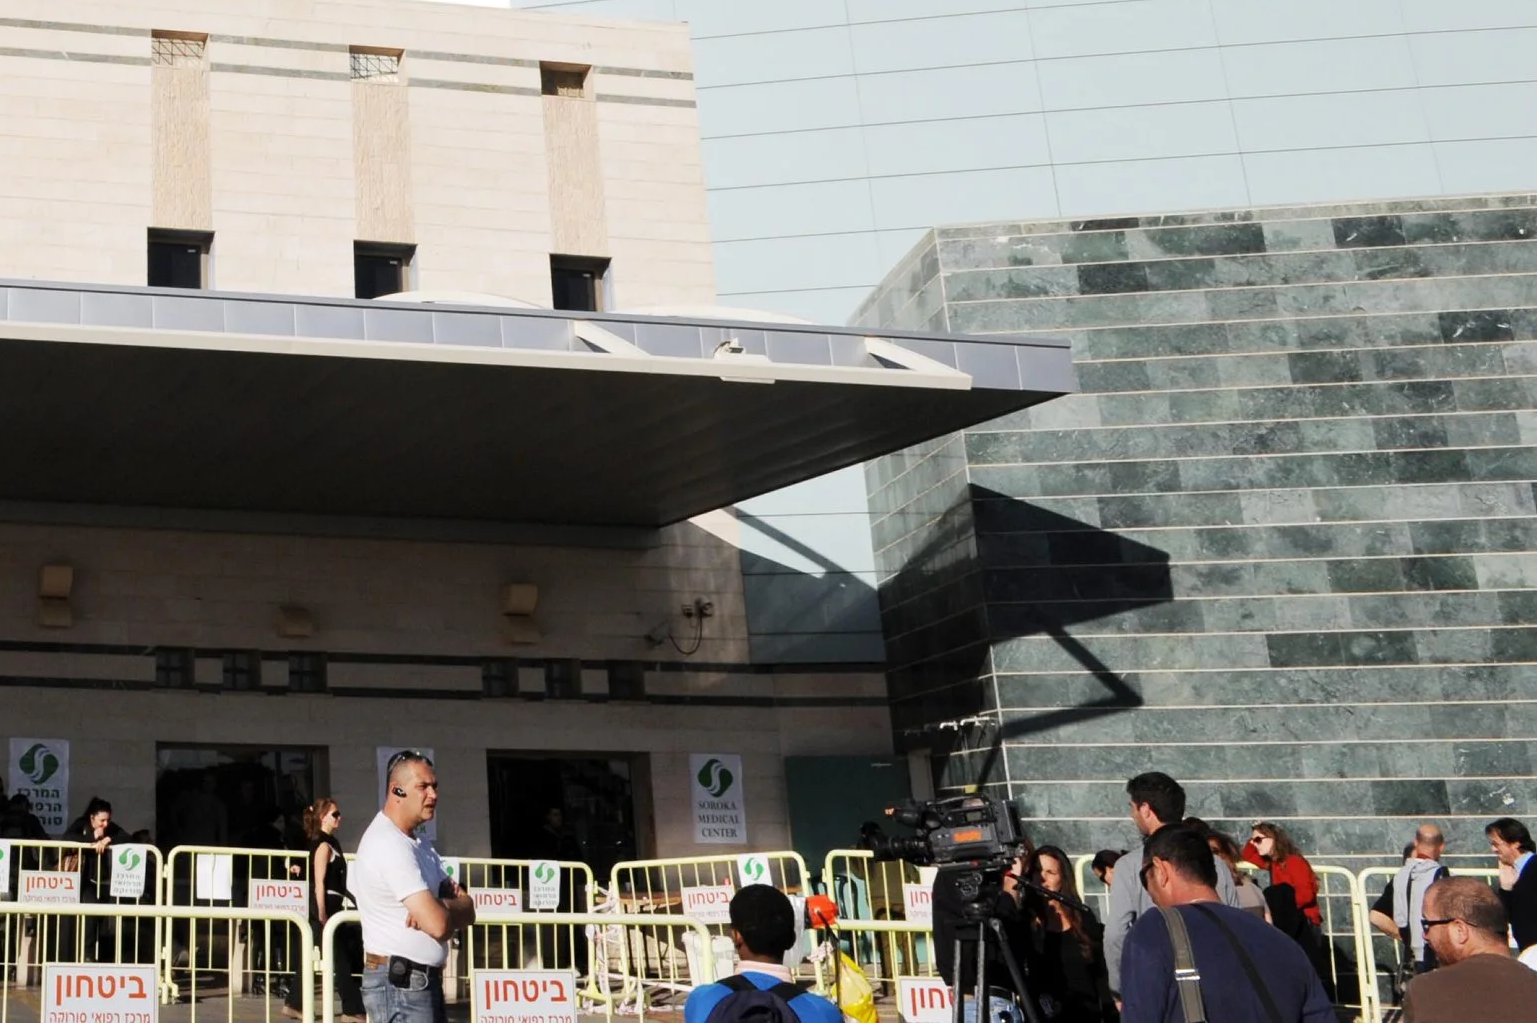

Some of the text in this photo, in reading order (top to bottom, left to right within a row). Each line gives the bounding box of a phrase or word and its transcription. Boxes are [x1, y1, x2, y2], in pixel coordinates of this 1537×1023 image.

[698, 801, 737, 810] SOROKA
[698, 814, 740, 824] MEDICAL
[701, 828, 738, 838] CENTER
[26, 876, 74, 893] ביטחון
[256, 885, 302, 901] ביטחון
[475, 893, 517, 908] ביטחון
[688, 892, 730, 908] ביטחון
[910, 891, 930, 907] חון
[56, 974, 147, 1006] ביטחון
[485, 979, 567, 1010] ביטחון
[911, 987, 953, 1016] חון
[91, 1012, 120, 1023] רפואי
[125, 1013, 151, 1023] מרכז
